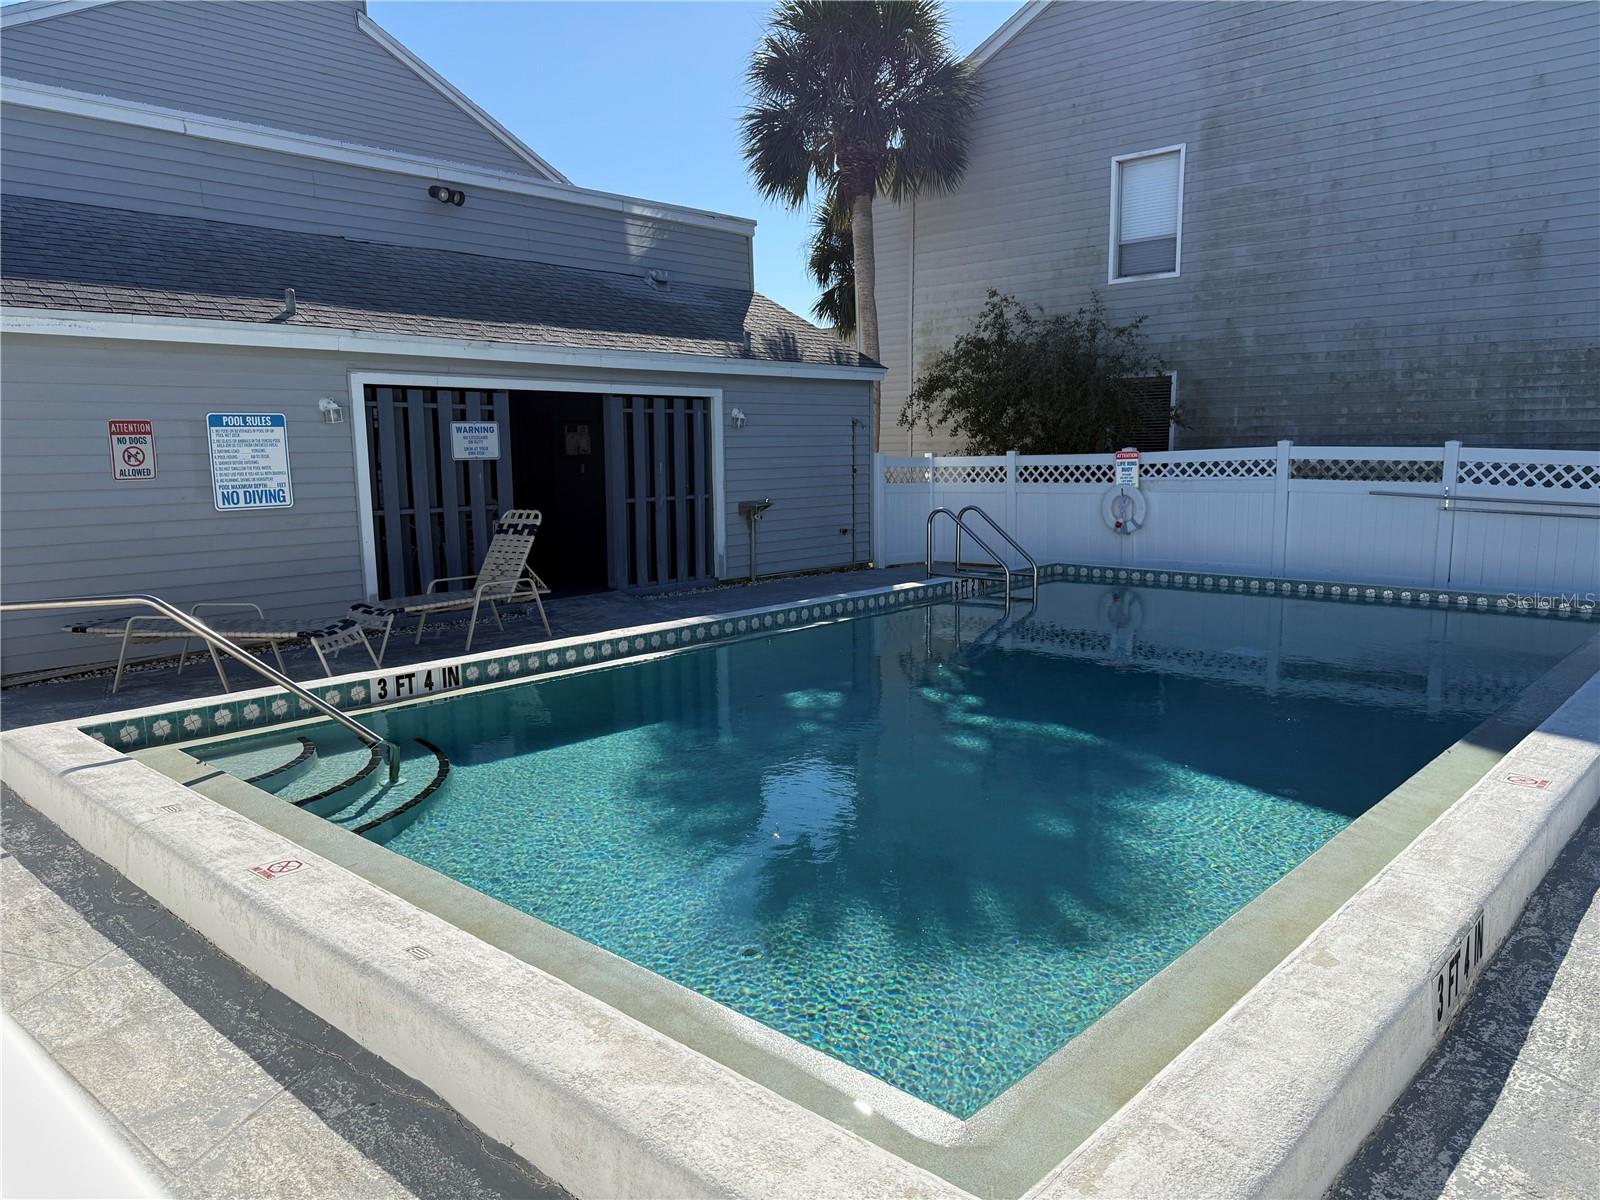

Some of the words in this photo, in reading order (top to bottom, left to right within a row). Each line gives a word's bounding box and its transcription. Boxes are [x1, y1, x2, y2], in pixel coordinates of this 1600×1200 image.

[222, 416, 244, 426] POOL
[246, 416, 272, 426] RULES
[111, 423, 151, 433] ATTENTION
[116, 436, 127, 445] NO
[129, 436, 148, 445] DOGS
[119, 468, 151, 477] ALLOWED
[221, 490, 240, 505] NO
[243, 489, 287, 505] DIVING
[377, 678, 388, 700] 3
[395, 672, 416, 697] FT
[424, 670, 434, 691] 4
[442, 665, 460, 689] IN
[1437, 974, 1444, 1022] 3
[1448, 948, 1461, 1008] FT
[1464, 934, 1470, 980] 4
[1473, 915, 1484, 969] IN
